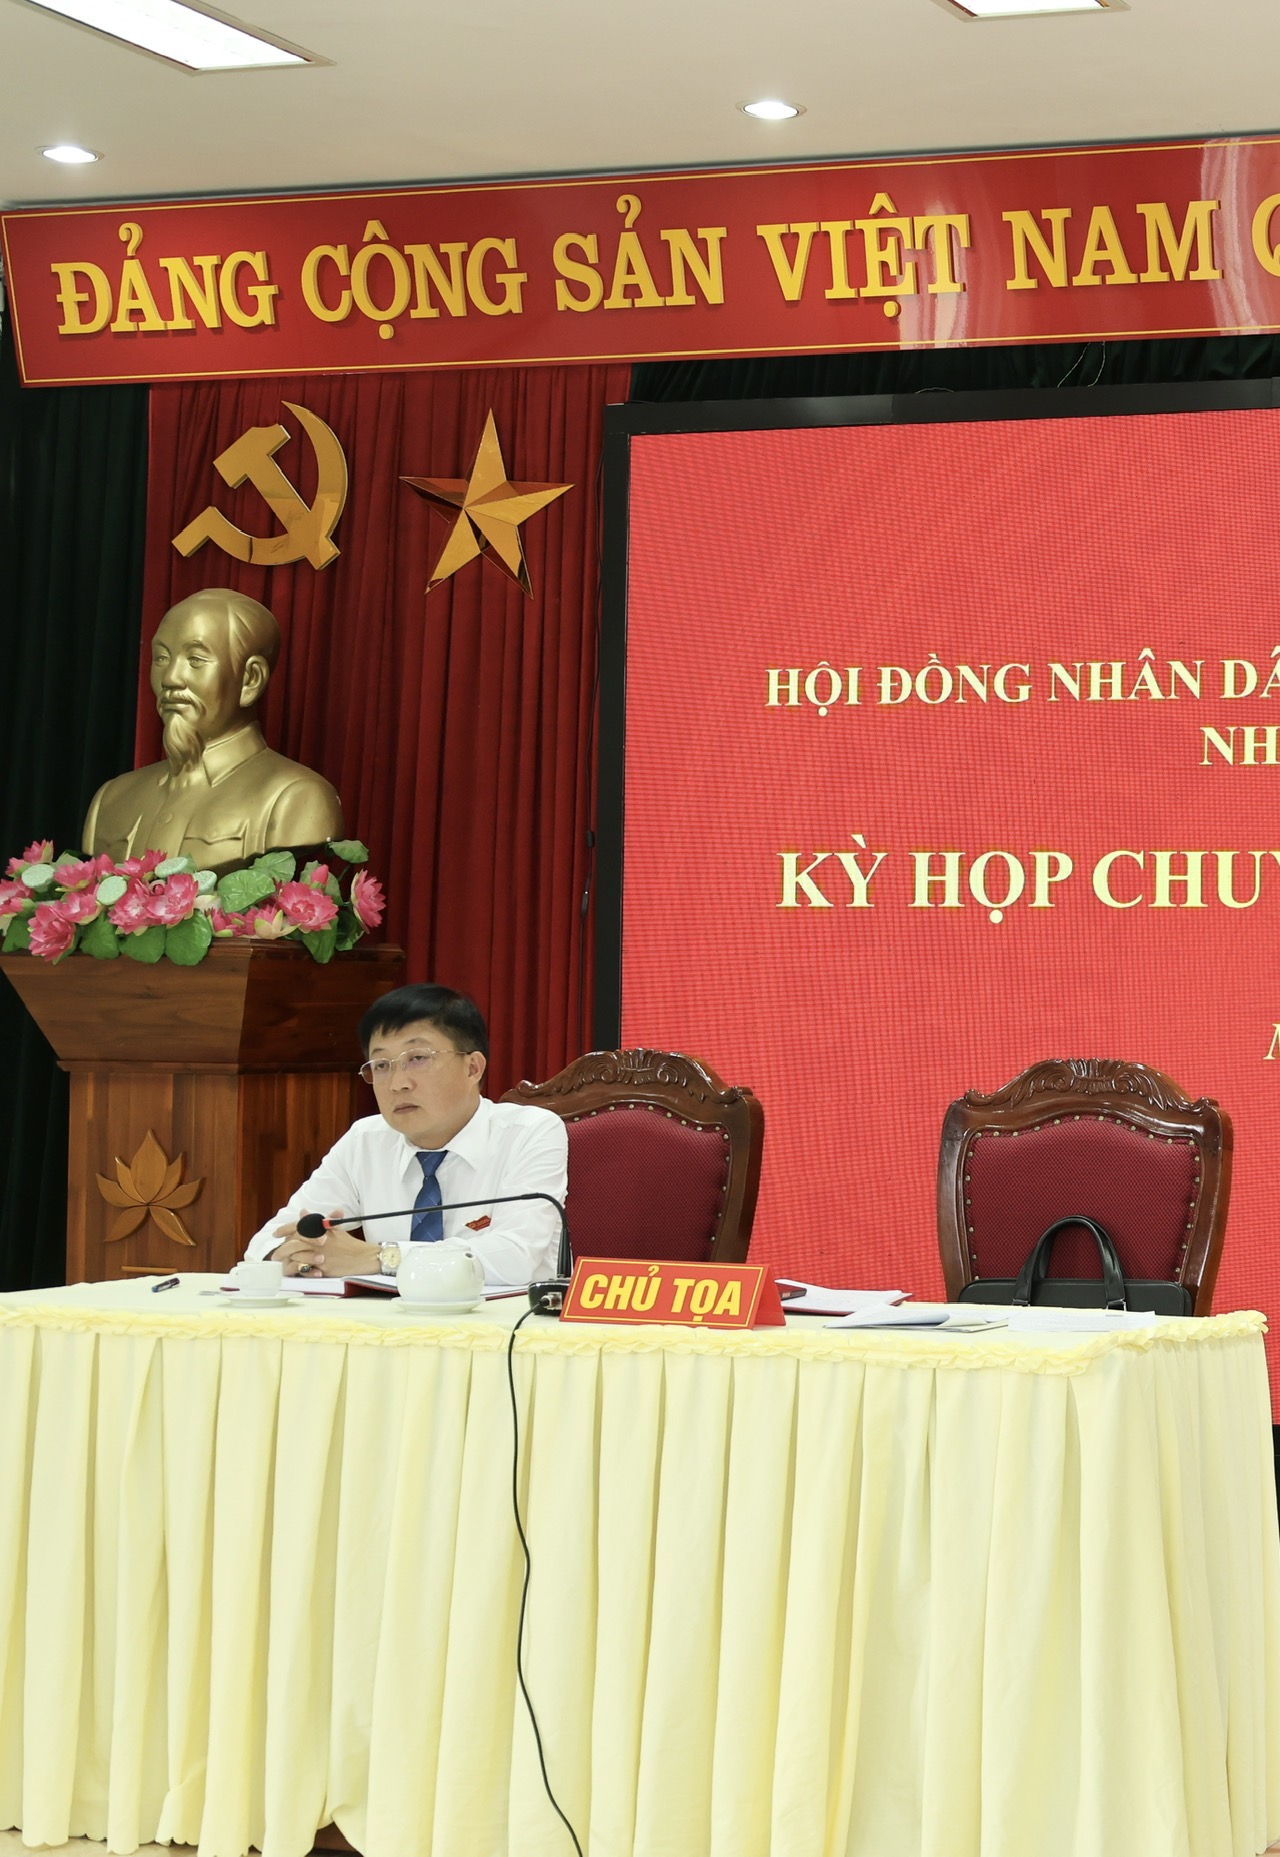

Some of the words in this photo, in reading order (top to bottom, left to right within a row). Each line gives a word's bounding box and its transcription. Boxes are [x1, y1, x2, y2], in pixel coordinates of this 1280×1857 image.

[51, 222, 278, 336] ĐẢNG
[302, 221, 527, 339] CỘNG
[554, 195, 726, 311] SẢN
[756, 193, 970, 318] VIỆT
[1003, 199, 1223, 291] NAM
[765, 661, 862, 716] HỘI
[877, 653, 1032, 704] ĐỒNG
[1047, 648, 1205, 701] NHÂN
[776, 834, 888, 907] KỲ
[908, 851, 1073, 924] HỌP
[579, 1265, 662, 1310] CHỦ
[670, 1279, 742, 1321] TỌA
